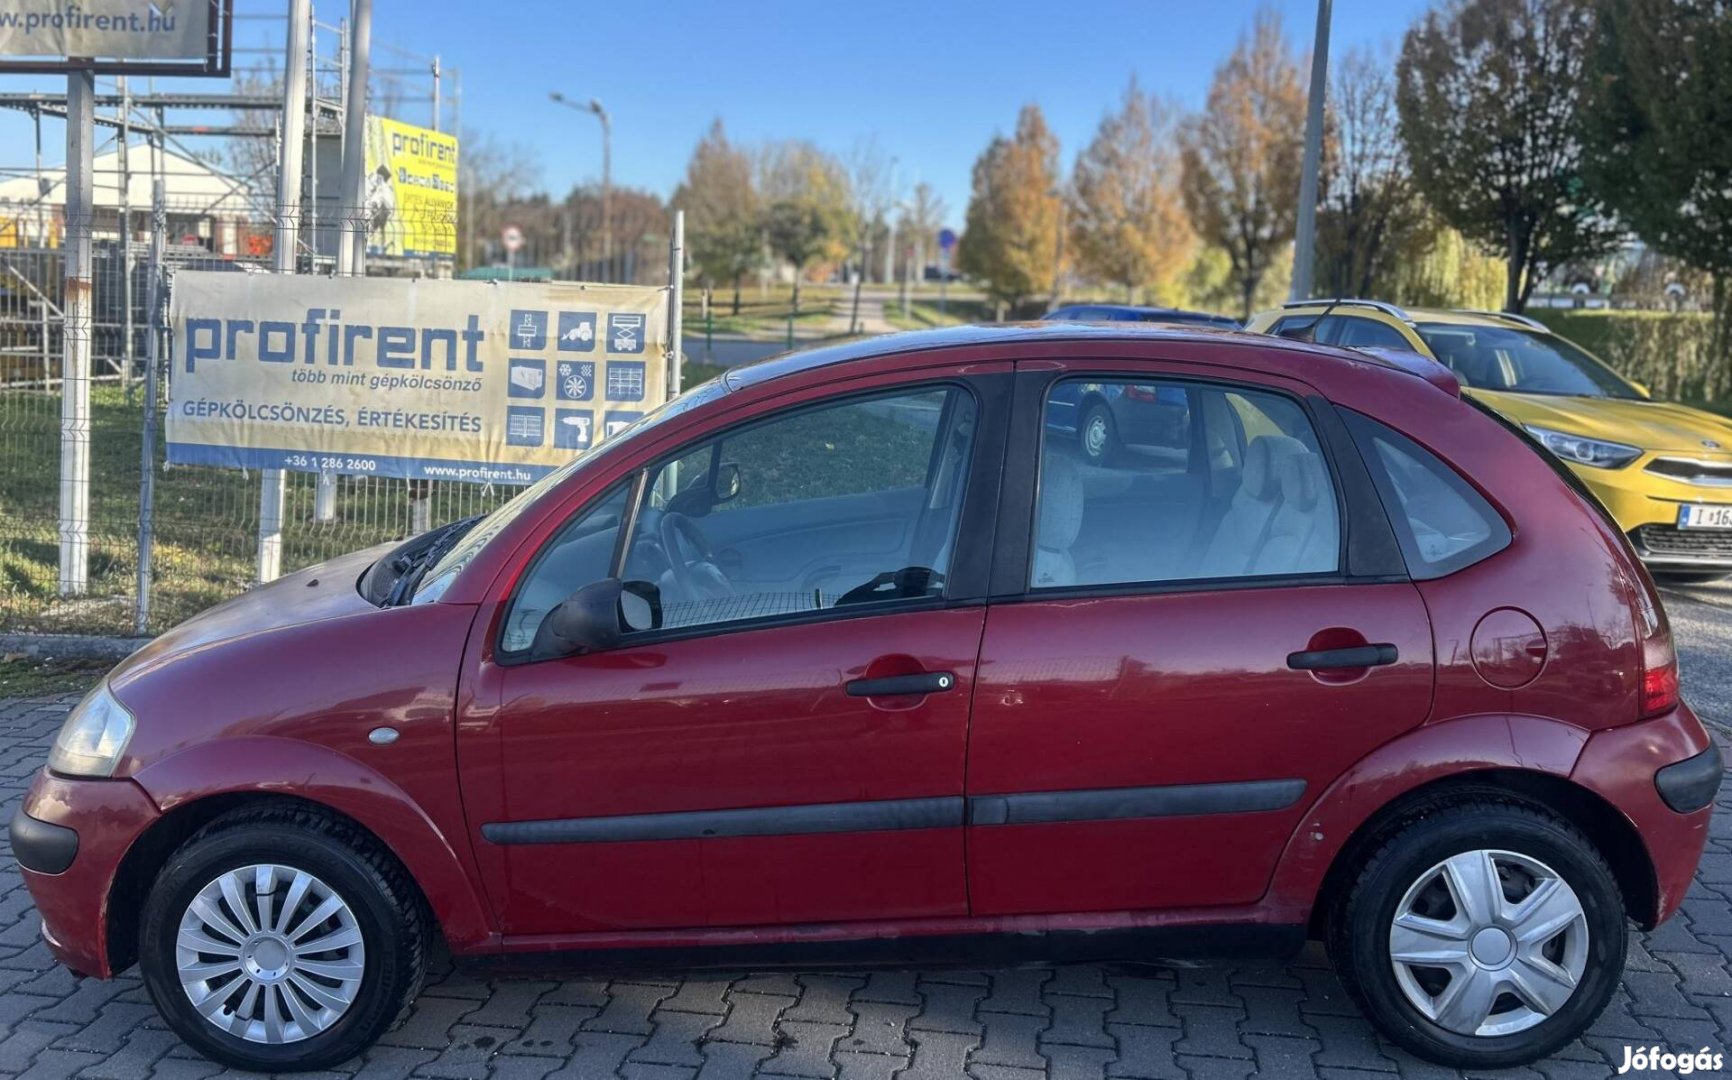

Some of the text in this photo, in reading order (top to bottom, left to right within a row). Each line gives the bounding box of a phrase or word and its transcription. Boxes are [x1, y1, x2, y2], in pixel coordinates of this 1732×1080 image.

[392, 132, 456, 164] profirent
[185, 308, 485, 373] profirent
[291, 368, 482, 392] több mint gépkölcsönző
[182, 398, 482, 433] GÉPKÖLCSÖNZÉS, ÉRTÉKESÍTÉS
[284, 455, 376, 471] +36 1 286 2600
[424, 465, 532, 481] www.profirent.hu
